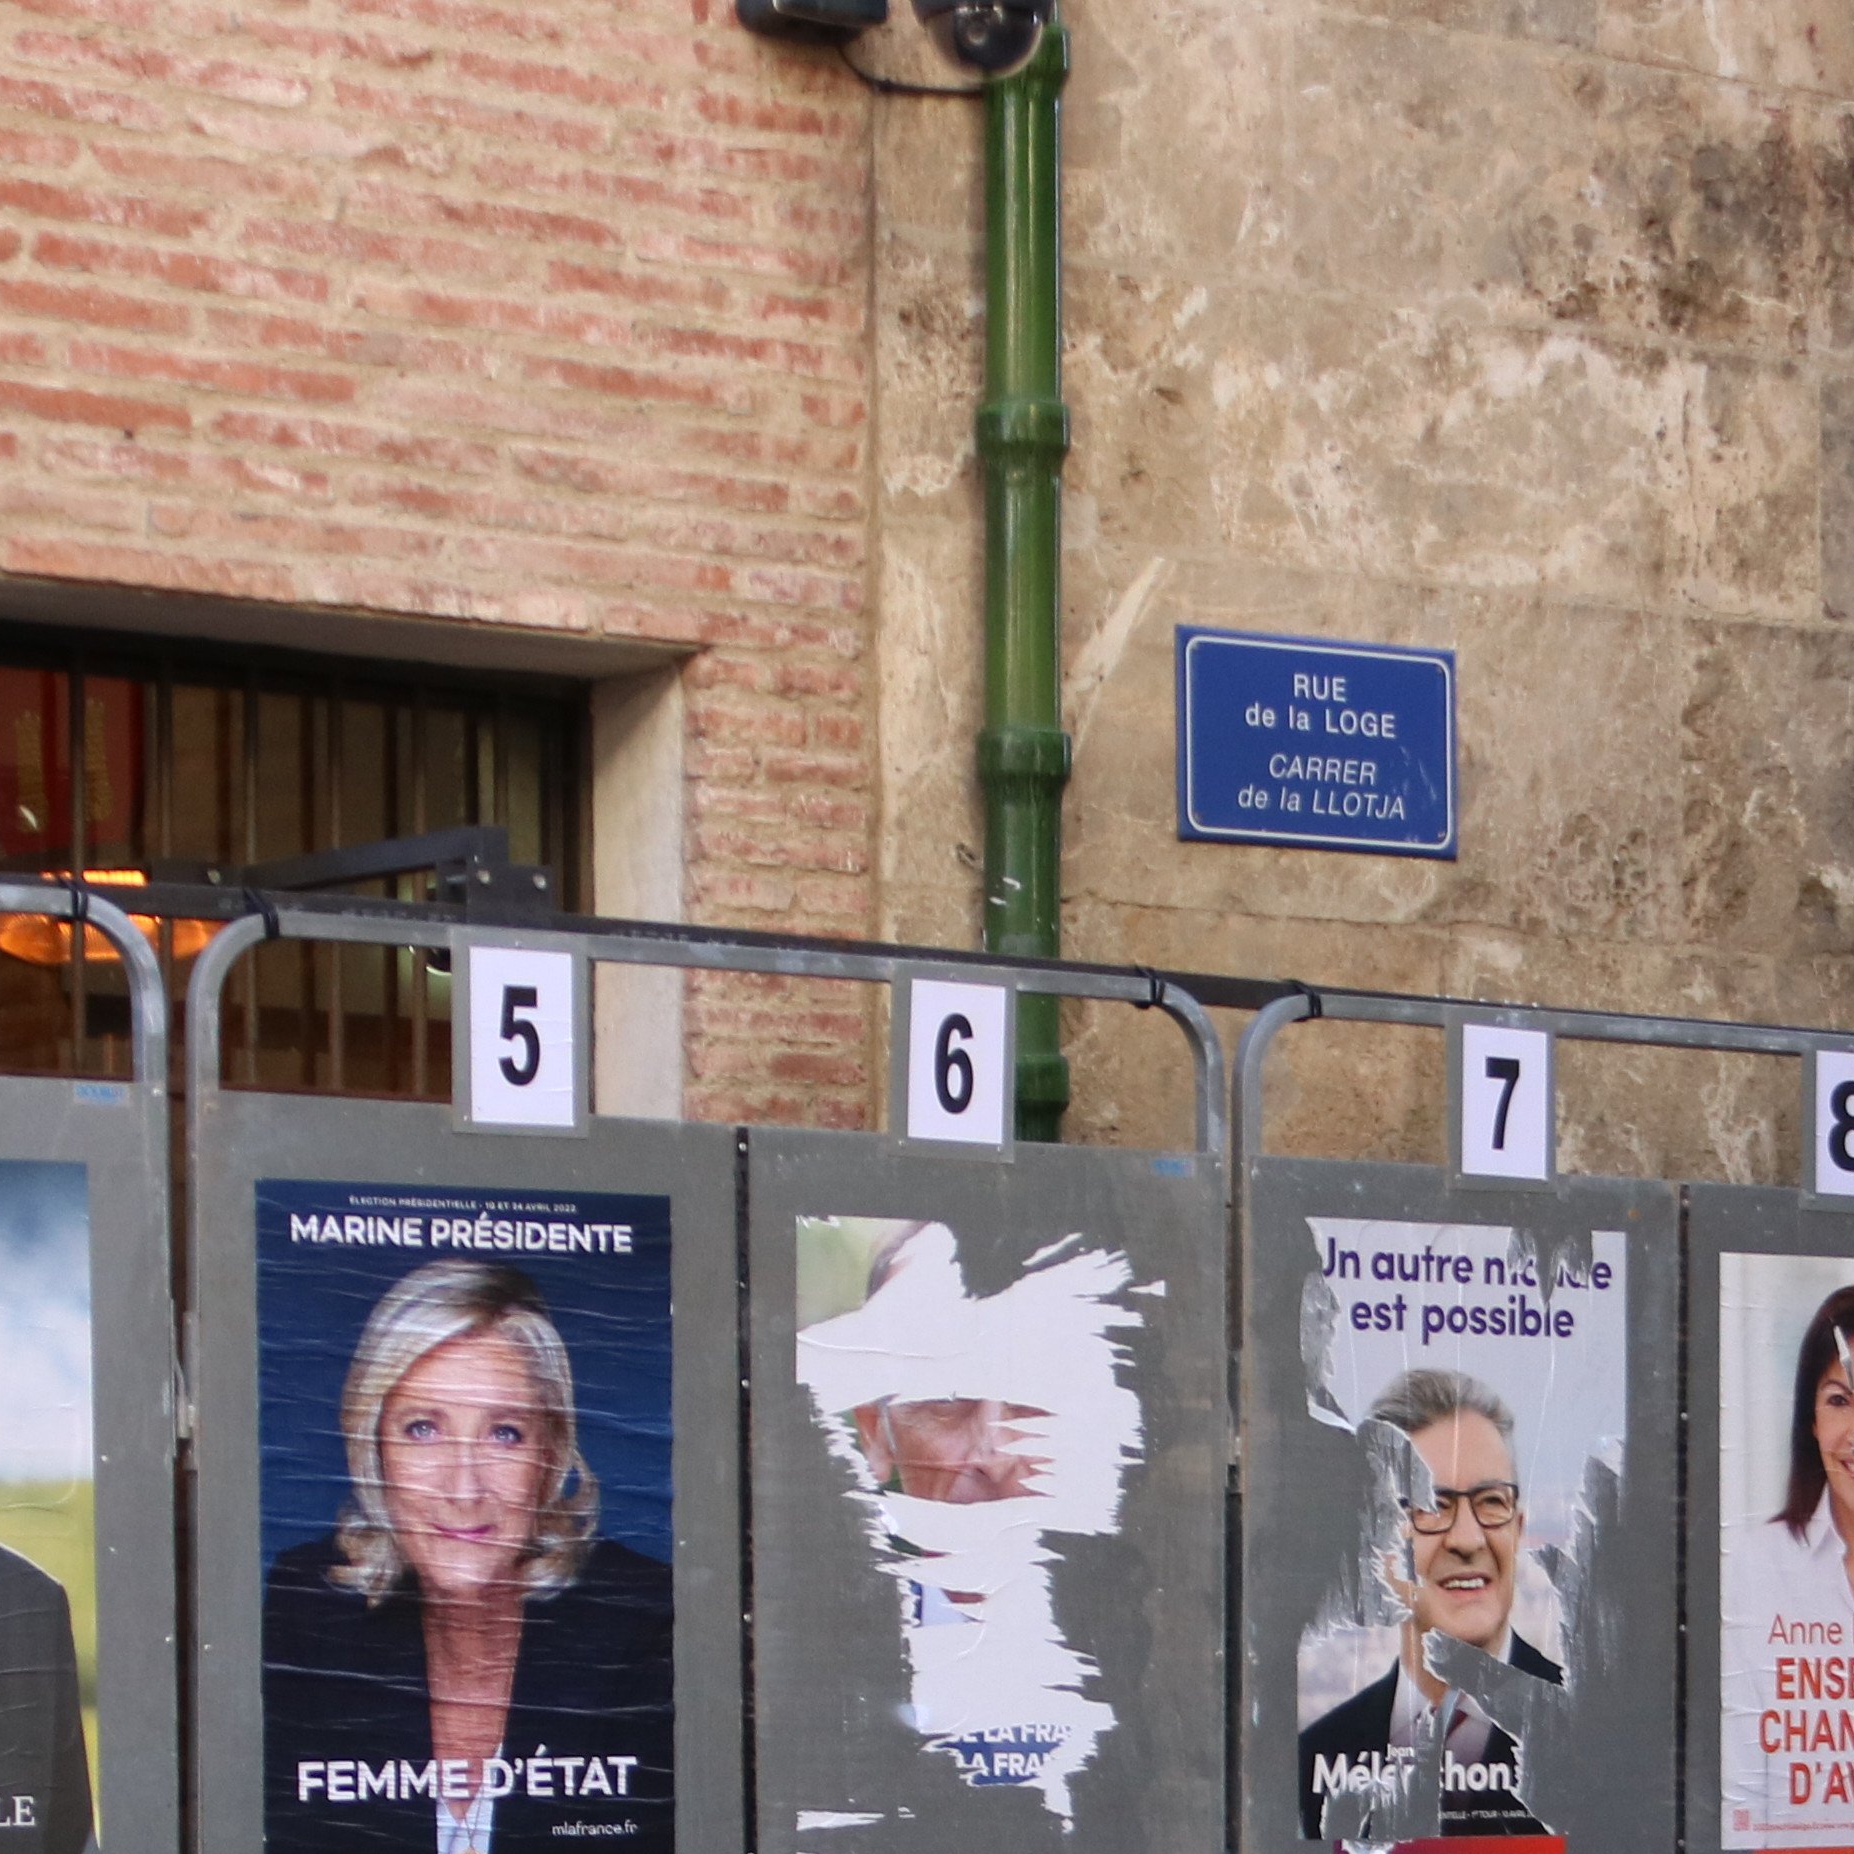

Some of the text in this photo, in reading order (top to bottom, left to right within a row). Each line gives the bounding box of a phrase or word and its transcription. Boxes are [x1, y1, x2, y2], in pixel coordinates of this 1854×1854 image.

[1293, 673, 1347, 702] RUE
[1246, 703, 1395, 738] de la LOGE
[1269, 754, 1376, 785] CARRER
[1238, 784, 1405, 820] de la LLOTJA
[498, 985, 540, 1086] 5
[934, 1012, 974, 1114] 6
[1485, 1056, 1520, 1150] 7
[291, 1211, 633, 1253] MARINE PRÉSIDENTE
[1370, 1245, 1473, 1284] autre
[1350, 1293, 1574, 1346] est possible
[1768, 1613, 1843, 1645] Anne
[297, 1743, 638, 1801] FEMME D'ÉTAT
[552, 1820, 638, 1837] mlafrance.fr
